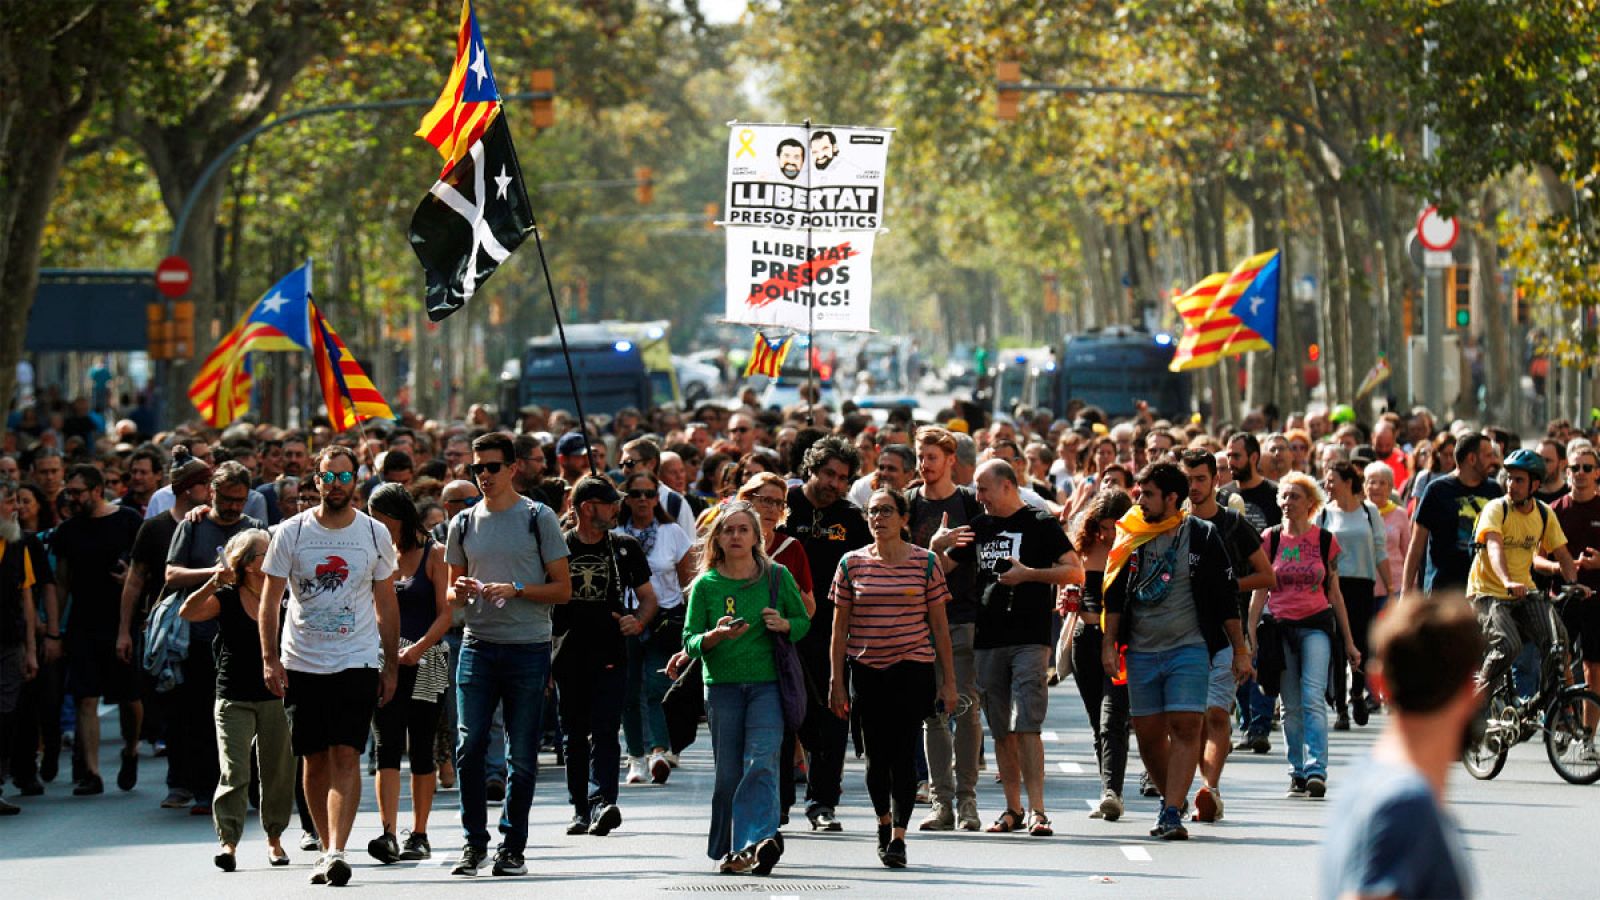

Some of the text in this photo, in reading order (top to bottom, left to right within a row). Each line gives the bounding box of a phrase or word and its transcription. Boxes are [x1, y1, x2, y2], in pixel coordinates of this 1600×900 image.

[734, 183, 874, 211] LLIBERTAT
[730, 211, 796, 226] PRESOS
[752, 240, 852, 262] LLIBERTAT
[751, 259, 850, 286] PRESOS
